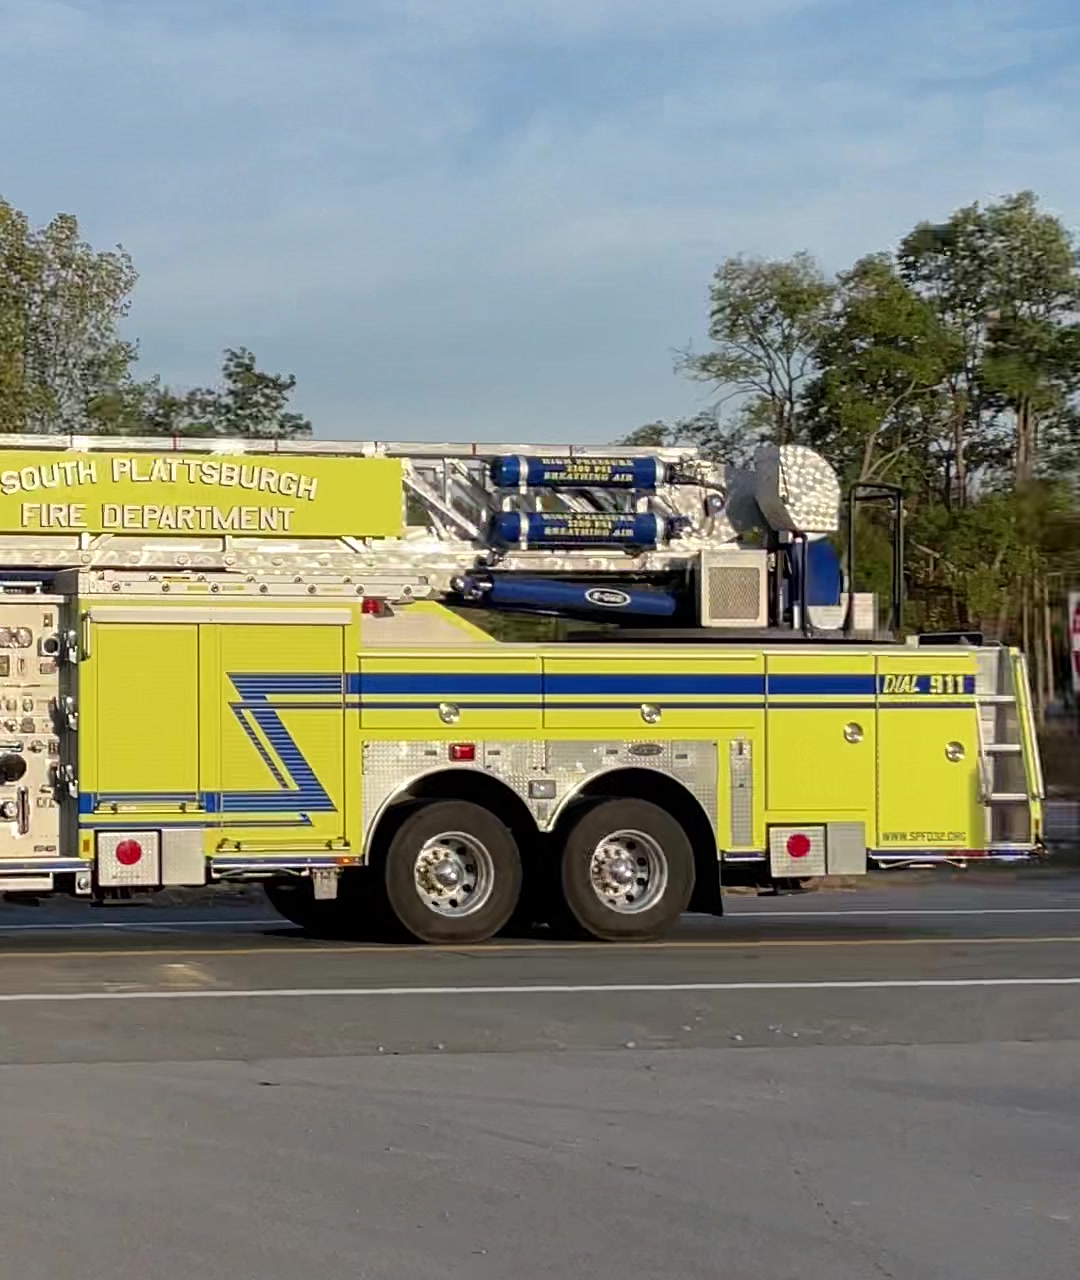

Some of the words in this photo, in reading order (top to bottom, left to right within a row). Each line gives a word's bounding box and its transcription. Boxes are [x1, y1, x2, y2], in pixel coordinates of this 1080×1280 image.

[0, 460, 98, 495] SOUTH
[111, 458, 317, 500] PLATTSBURGH
[20, 503, 88, 527] FIRE
[101, 503, 295, 531] DEPARTMENT
[883, 674, 920, 694] DIAL
[930, 674, 964, 694] 911
